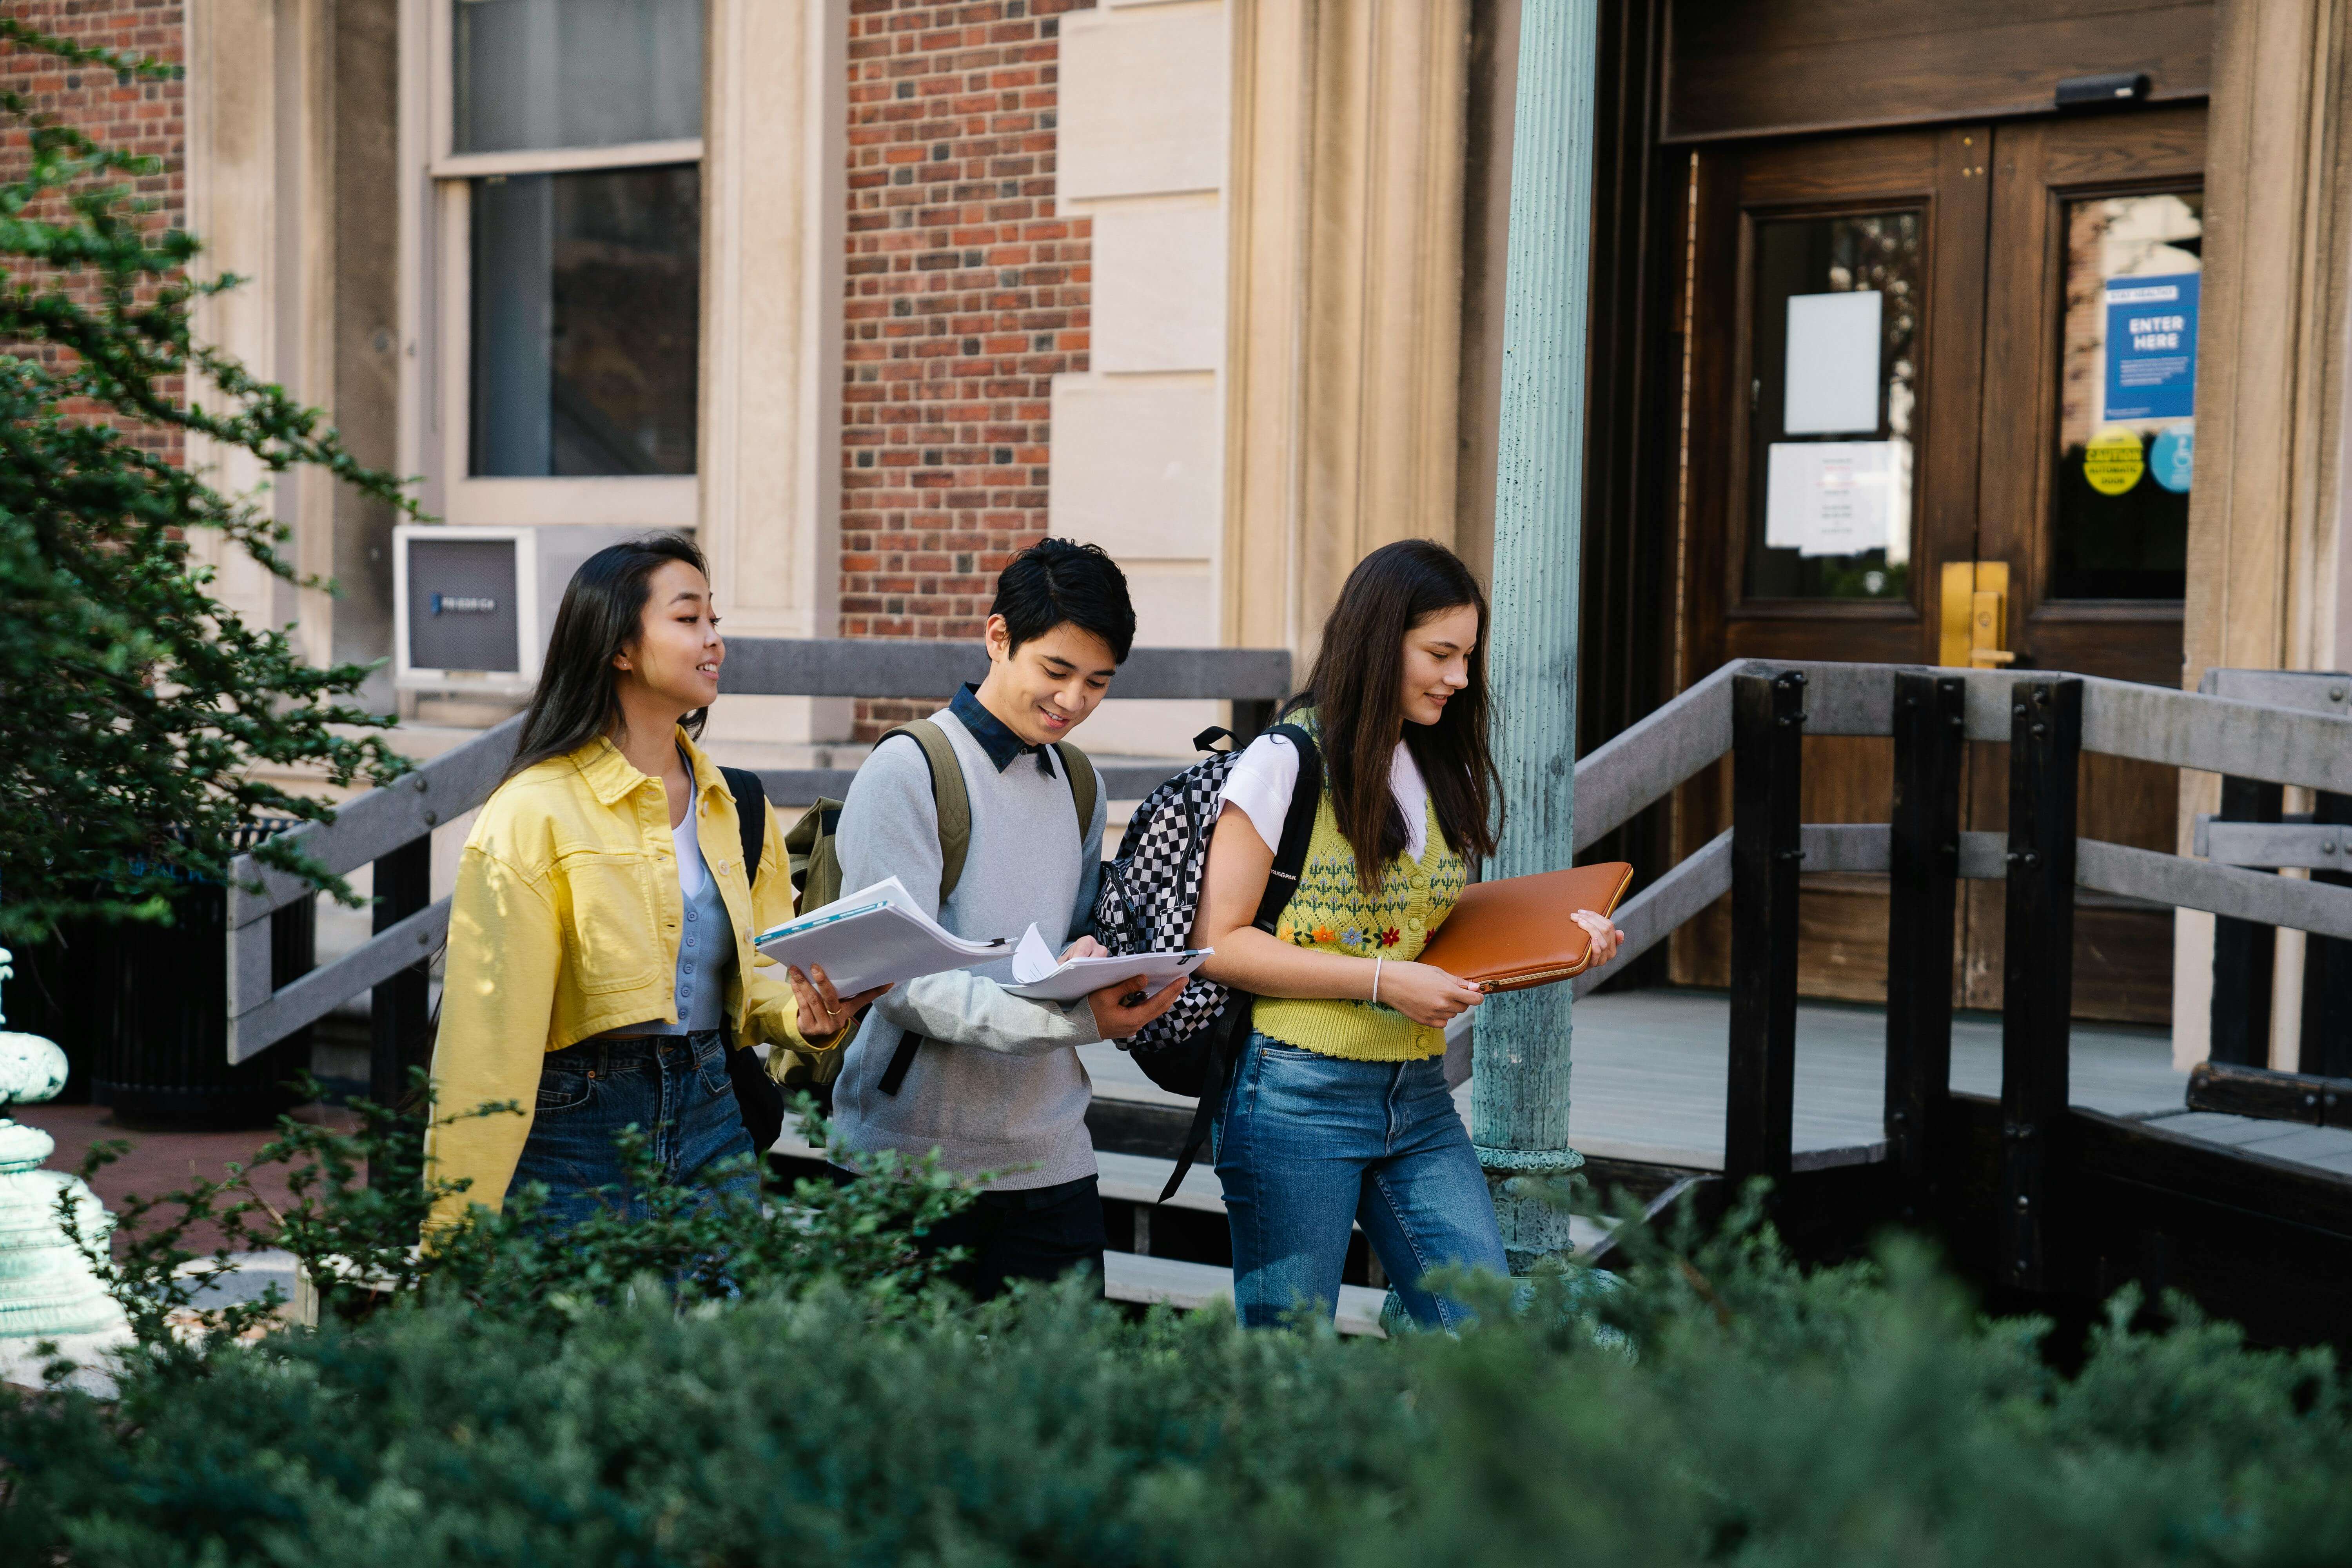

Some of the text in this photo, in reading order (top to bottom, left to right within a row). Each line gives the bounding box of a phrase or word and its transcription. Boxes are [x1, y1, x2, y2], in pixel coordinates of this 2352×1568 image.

[2129, 315, 2184, 334] ENTER
[2134, 333, 2179, 351] HERE
[2089, 465, 2137, 474] AUTOMATIC
[2101, 476, 2125, 485] DOOR
